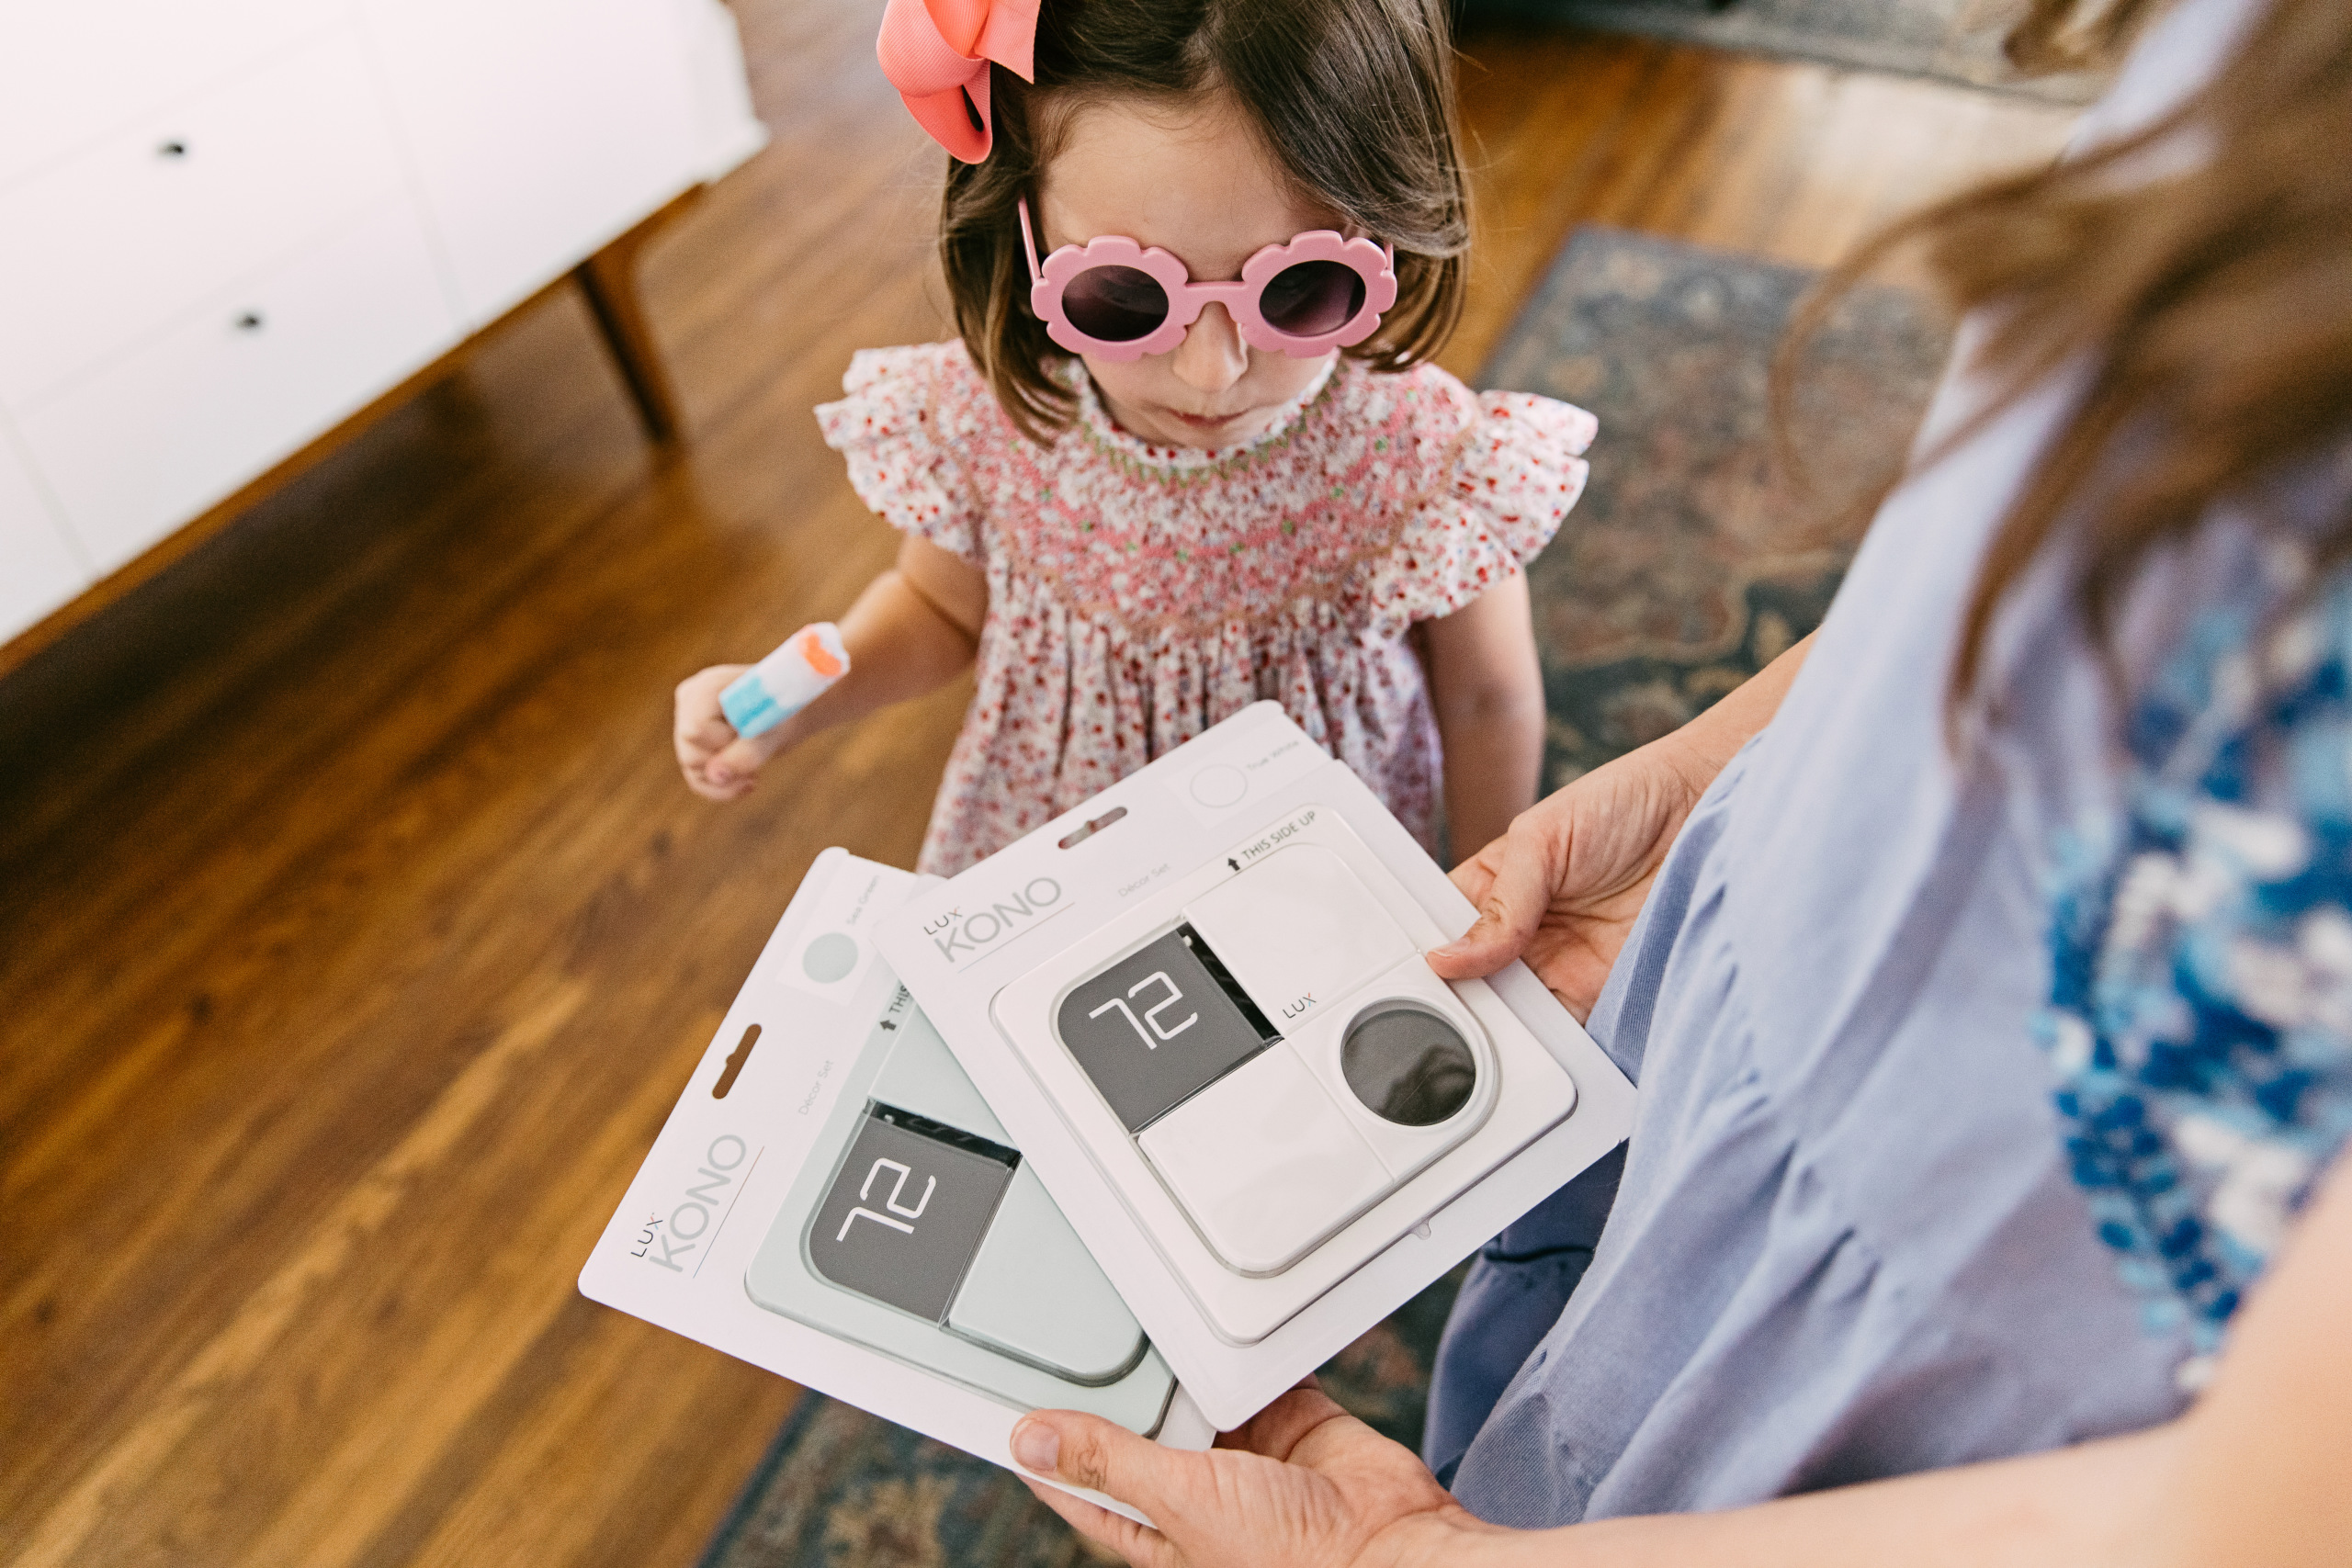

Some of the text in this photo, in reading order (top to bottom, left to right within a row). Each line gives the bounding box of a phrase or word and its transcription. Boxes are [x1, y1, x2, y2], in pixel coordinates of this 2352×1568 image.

[1241, 810, 1316, 860] THIS SIDE UP
[1118, 863, 1171, 897] Décor Set
[923, 907, 963, 936] LUX
[933, 877, 1062, 963] KONO
[1088, 971, 1198, 1050] 72
[1283, 992, 1317, 1019] LUX
[798, 1059, 834, 1116] Décor Set
[649, 1134, 747, 1273] KONO
[836, 1157, 937, 1242] 72
[630, 1214, 663, 1258] LUX
